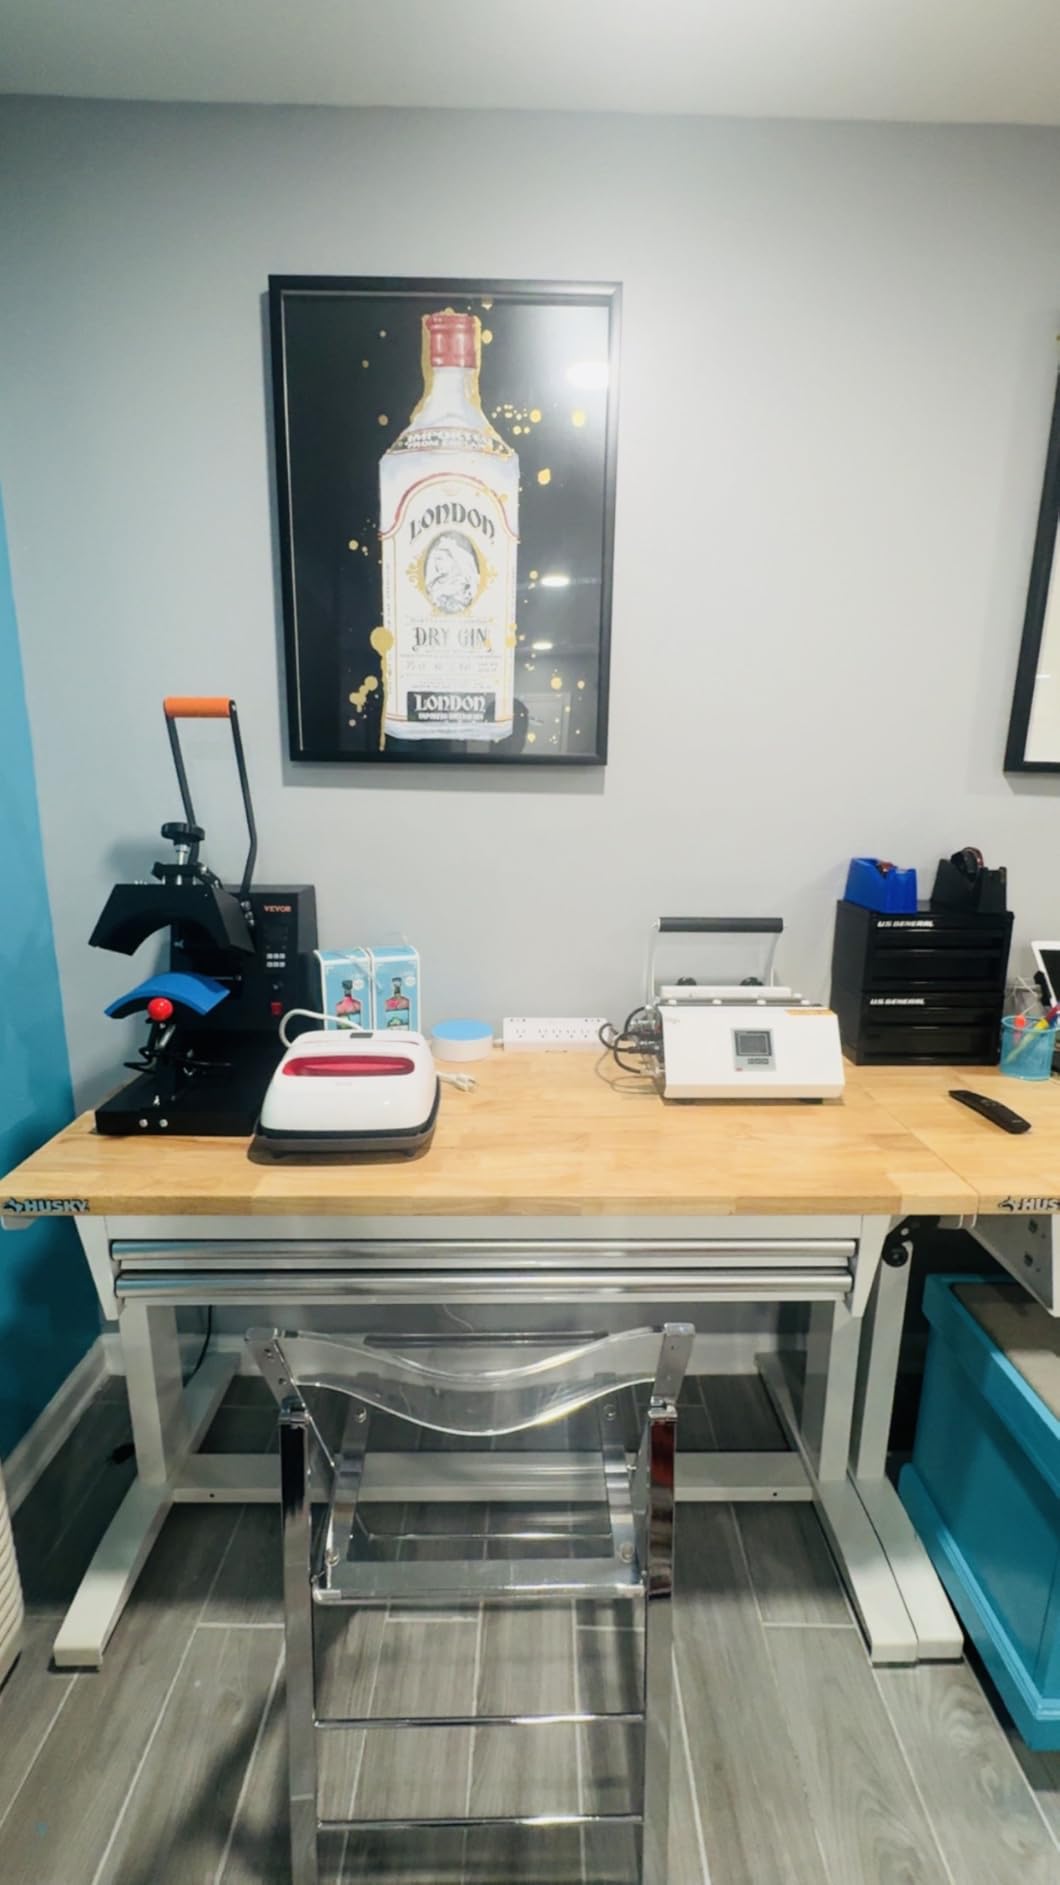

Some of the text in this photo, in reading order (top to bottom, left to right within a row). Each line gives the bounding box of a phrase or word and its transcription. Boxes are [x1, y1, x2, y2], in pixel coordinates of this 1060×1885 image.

[409, 502, 495, 544] LONDON
[412, 626, 491, 652] DRY GIN
[414, 694, 486, 713] LONDON
[264, 905, 292, 913] VEVOR
[893, 920, 934, 928] GENERAL
[24, 1199, 88, 1211] HUSKY
